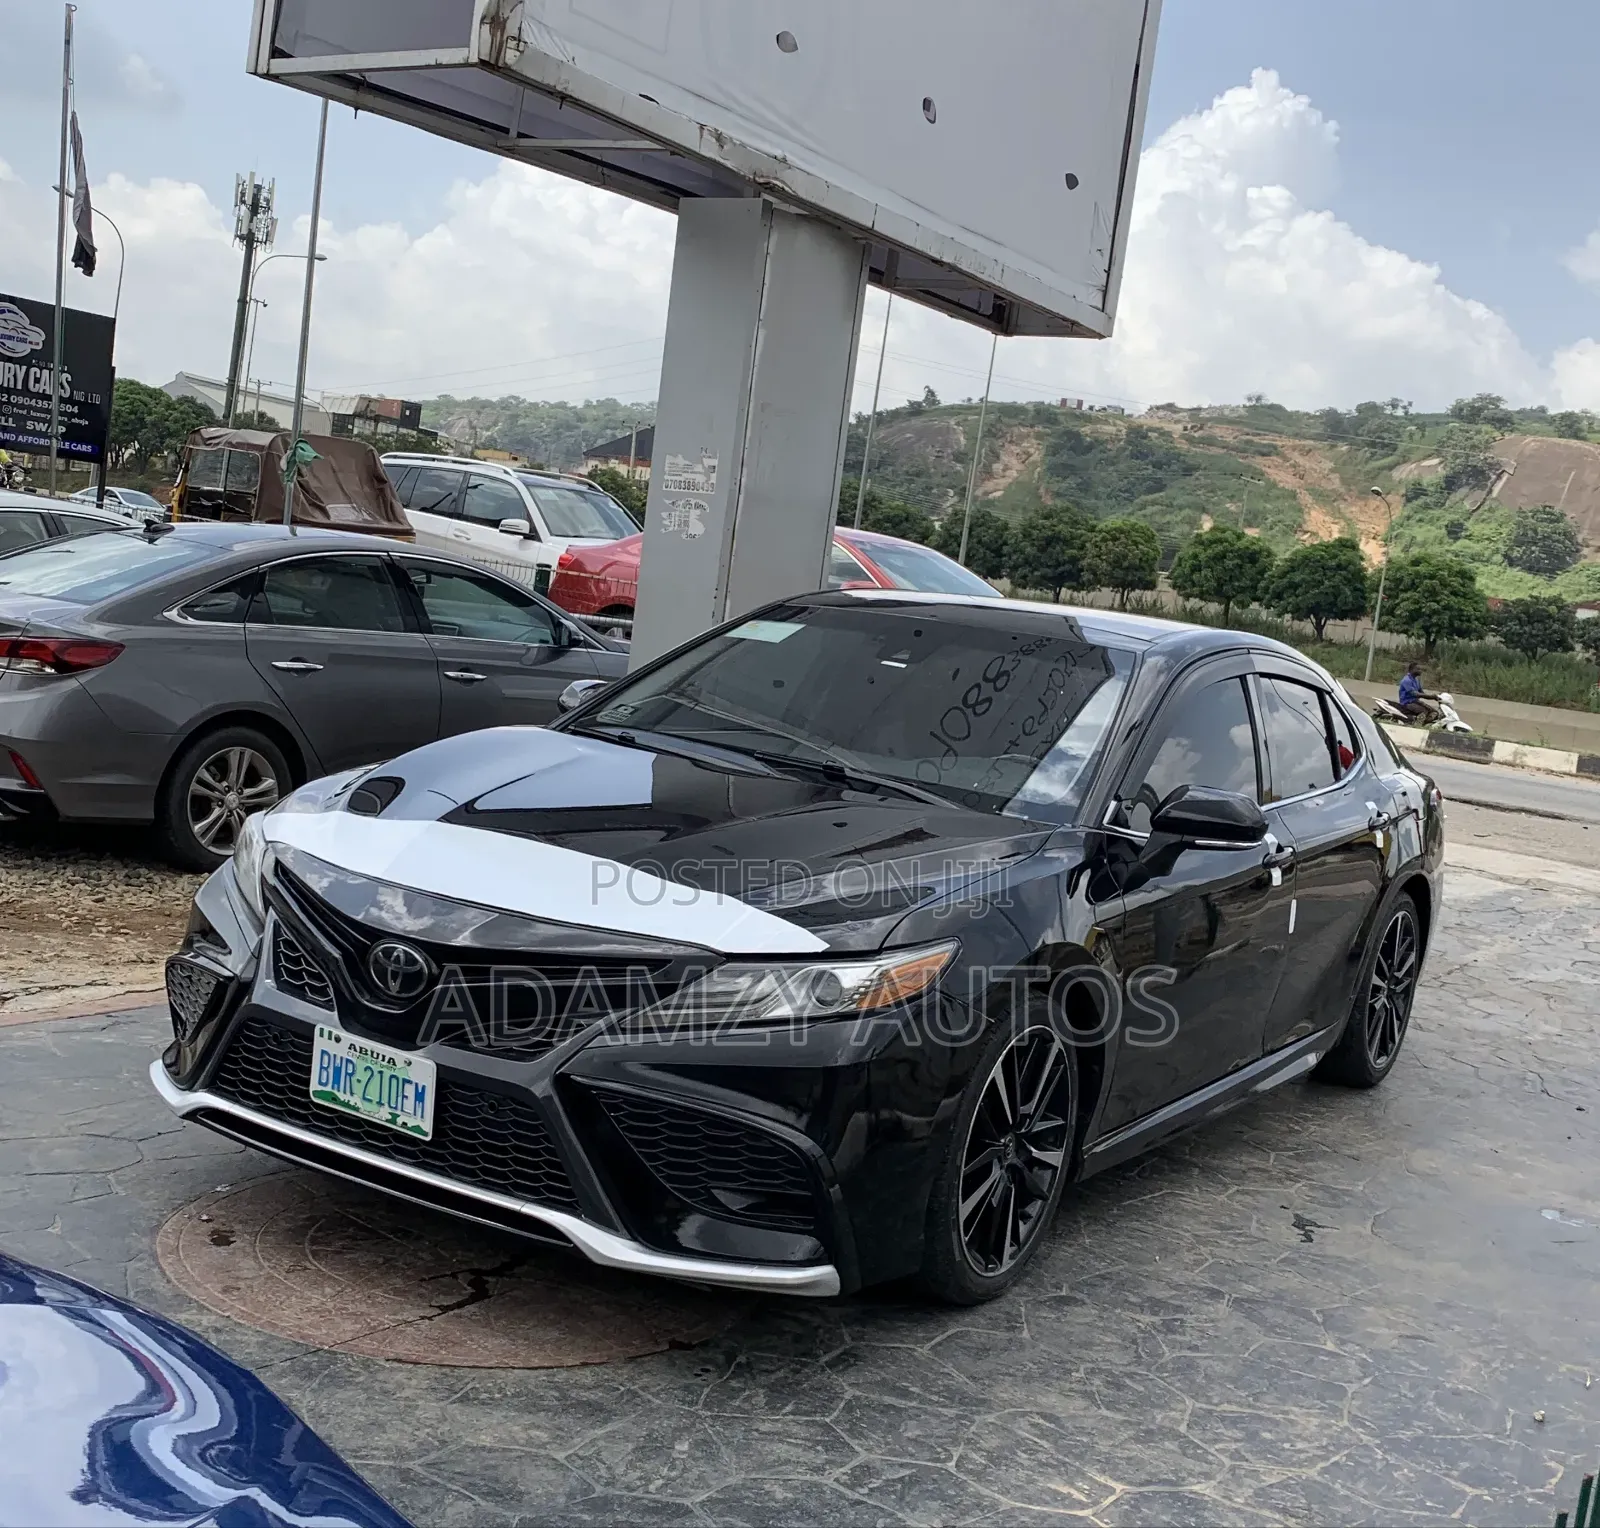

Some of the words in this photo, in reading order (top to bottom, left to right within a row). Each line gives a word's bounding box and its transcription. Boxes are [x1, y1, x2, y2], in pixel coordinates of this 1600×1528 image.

[10, 395, 79, 413] 0904357504
[88, 392, 100, 405] LTD
[70, 443, 92, 453] CARS
[348, 1043, 397, 1067] ABUJA
[318, 1048, 427, 1120] BWR-210EM
